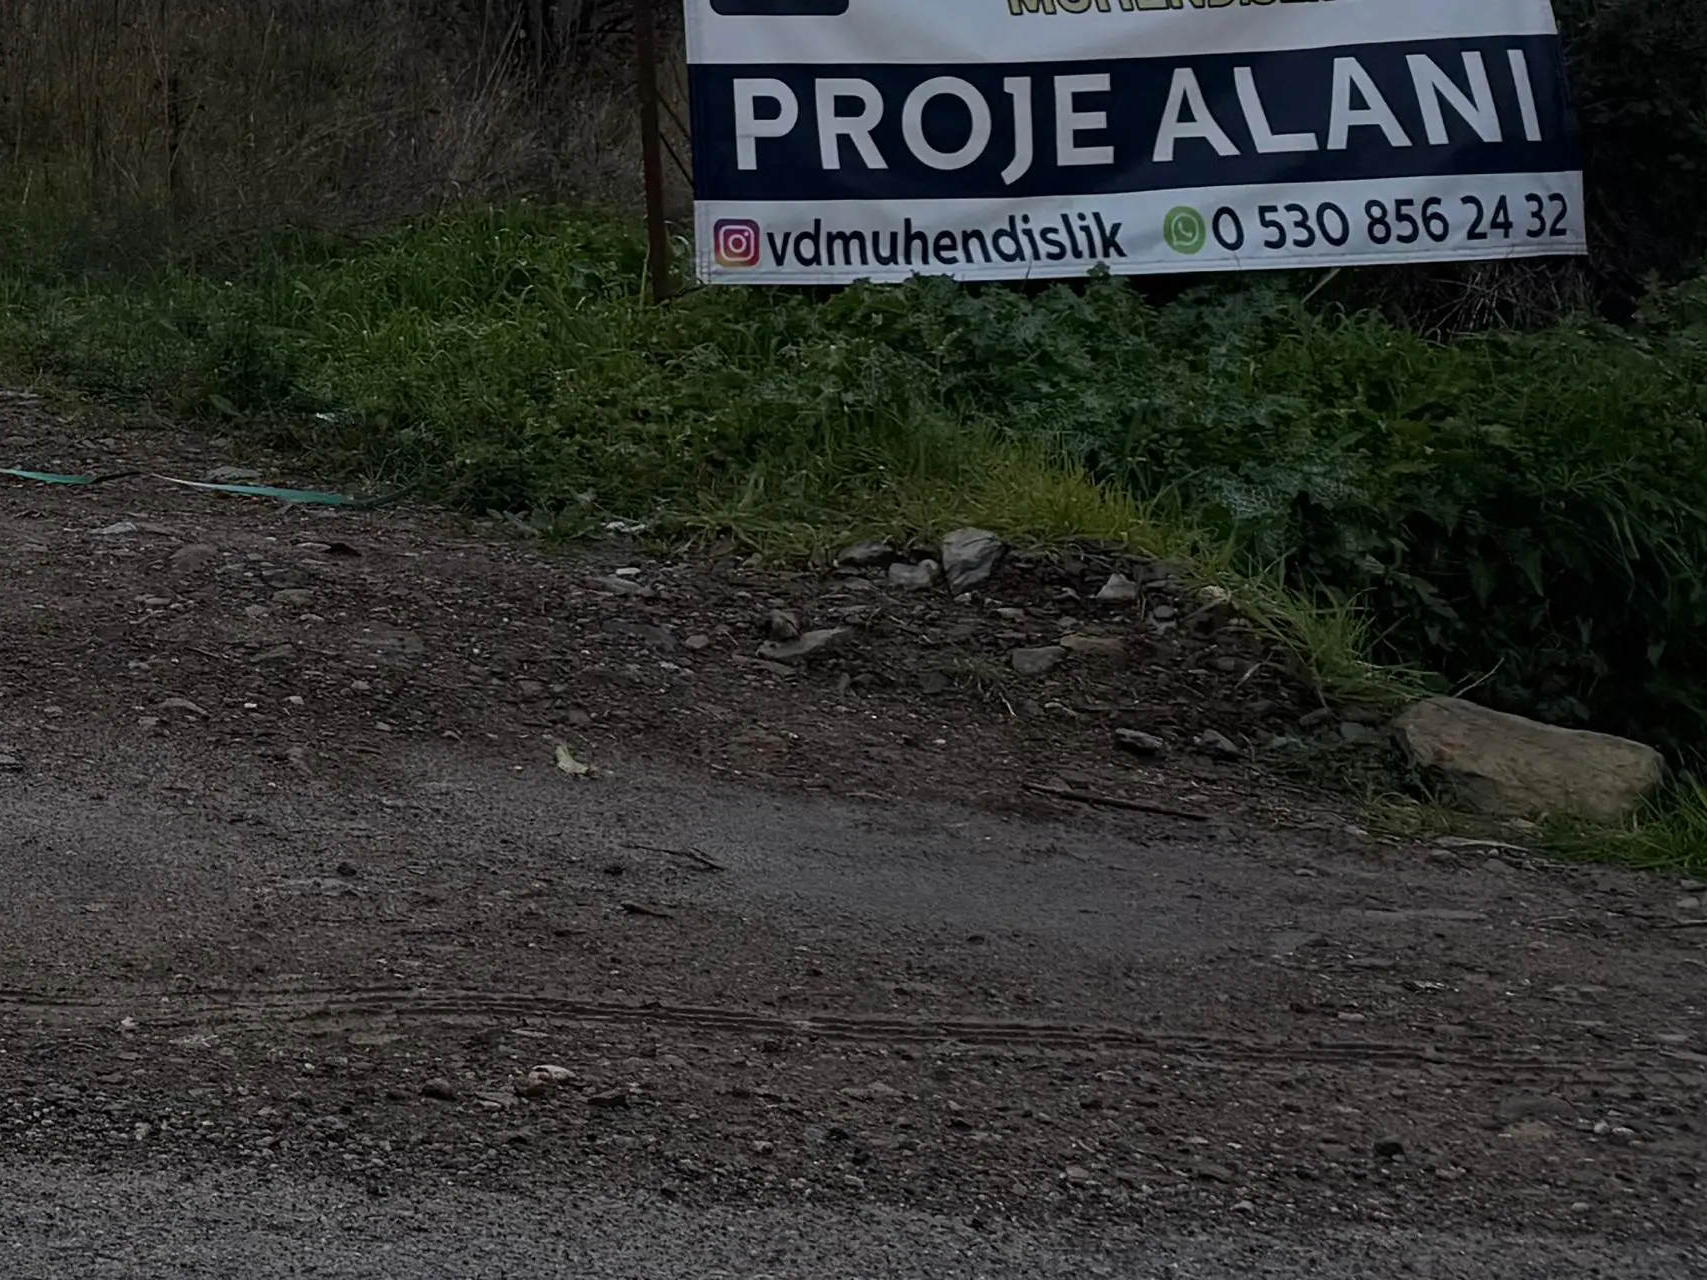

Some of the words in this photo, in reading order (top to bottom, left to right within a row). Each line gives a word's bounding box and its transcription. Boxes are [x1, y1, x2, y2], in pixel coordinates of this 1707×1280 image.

[733, 73, 1115, 186] PROJE
[1152, 48, 1542, 163] ALANI
[767, 211, 1128, 268] vdmuhendislik
[1212, 205, 1245, 251] 0
[1261, 201, 1350, 250] 530
[1363, 196, 1449, 245] 856
[1459, 193, 1515, 241] 24
[1524, 192, 1569, 238] 32
